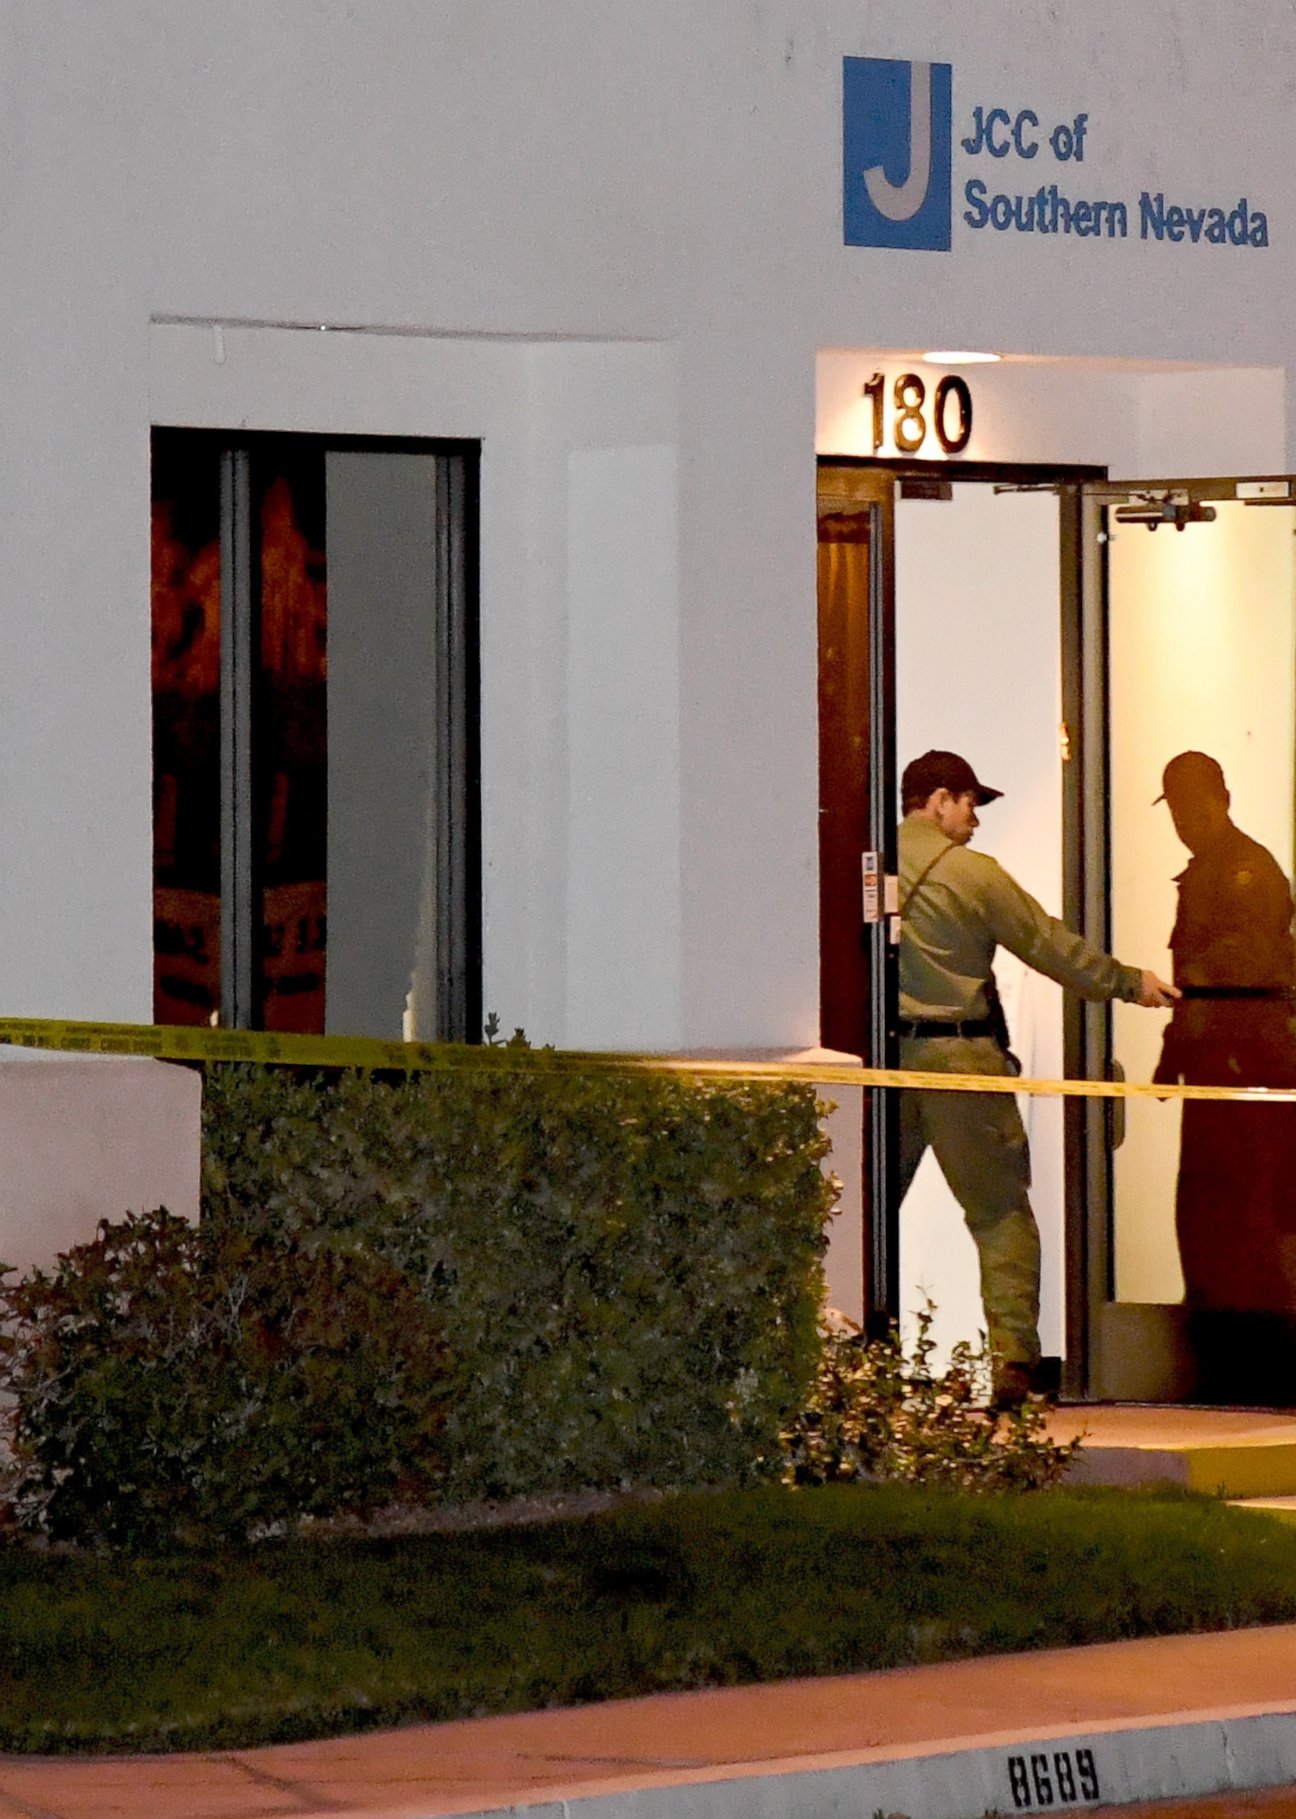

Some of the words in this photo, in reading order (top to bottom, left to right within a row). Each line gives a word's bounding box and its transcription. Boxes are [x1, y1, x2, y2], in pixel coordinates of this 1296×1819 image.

[863, 61, 932, 222] J
[960, 106, 1039, 159] JCC
[1050, 113, 1089, 162] of
[963, 179, 1128, 238] Southern
[1139, 191, 1269, 247] Nevada
[863, 372, 973, 453] 180
[1007, 1748, 1100, 1808] 8689
